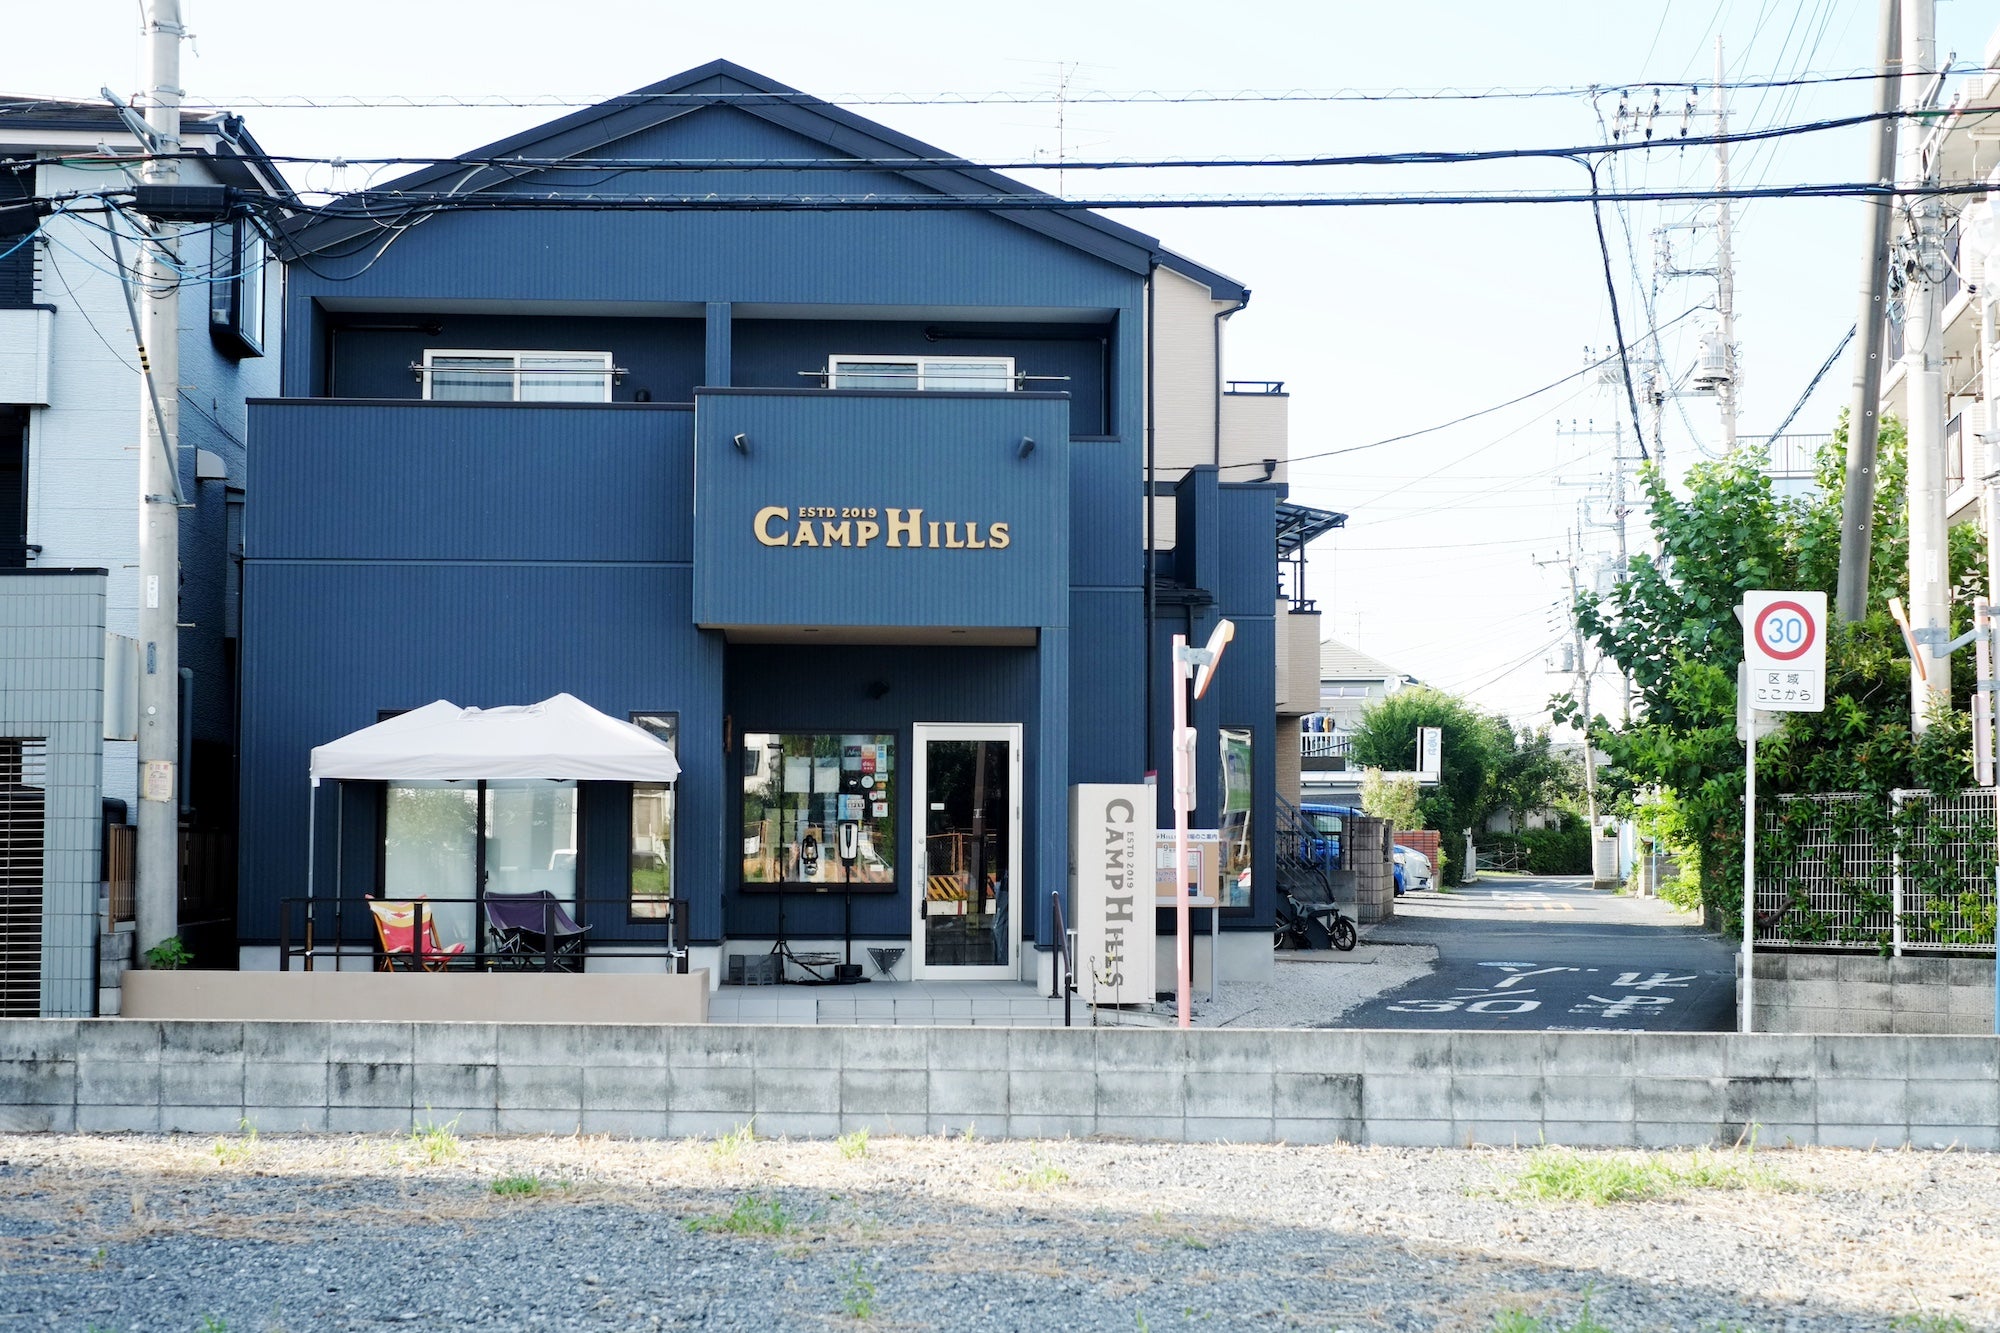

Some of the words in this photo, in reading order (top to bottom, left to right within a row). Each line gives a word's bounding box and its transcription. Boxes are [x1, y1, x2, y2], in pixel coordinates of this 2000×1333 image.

[841, 507, 878, 518] 2019
[1767, 617, 1803, 644] 30
[1768, 672, 1800, 685] 区域
[1757, 688, 1812, 702] ここから
[1126, 831, 1135, 859] ESTD
[1126, 862, 1135, 890] 2019
[1386, 999, 1542, 1014] 30
